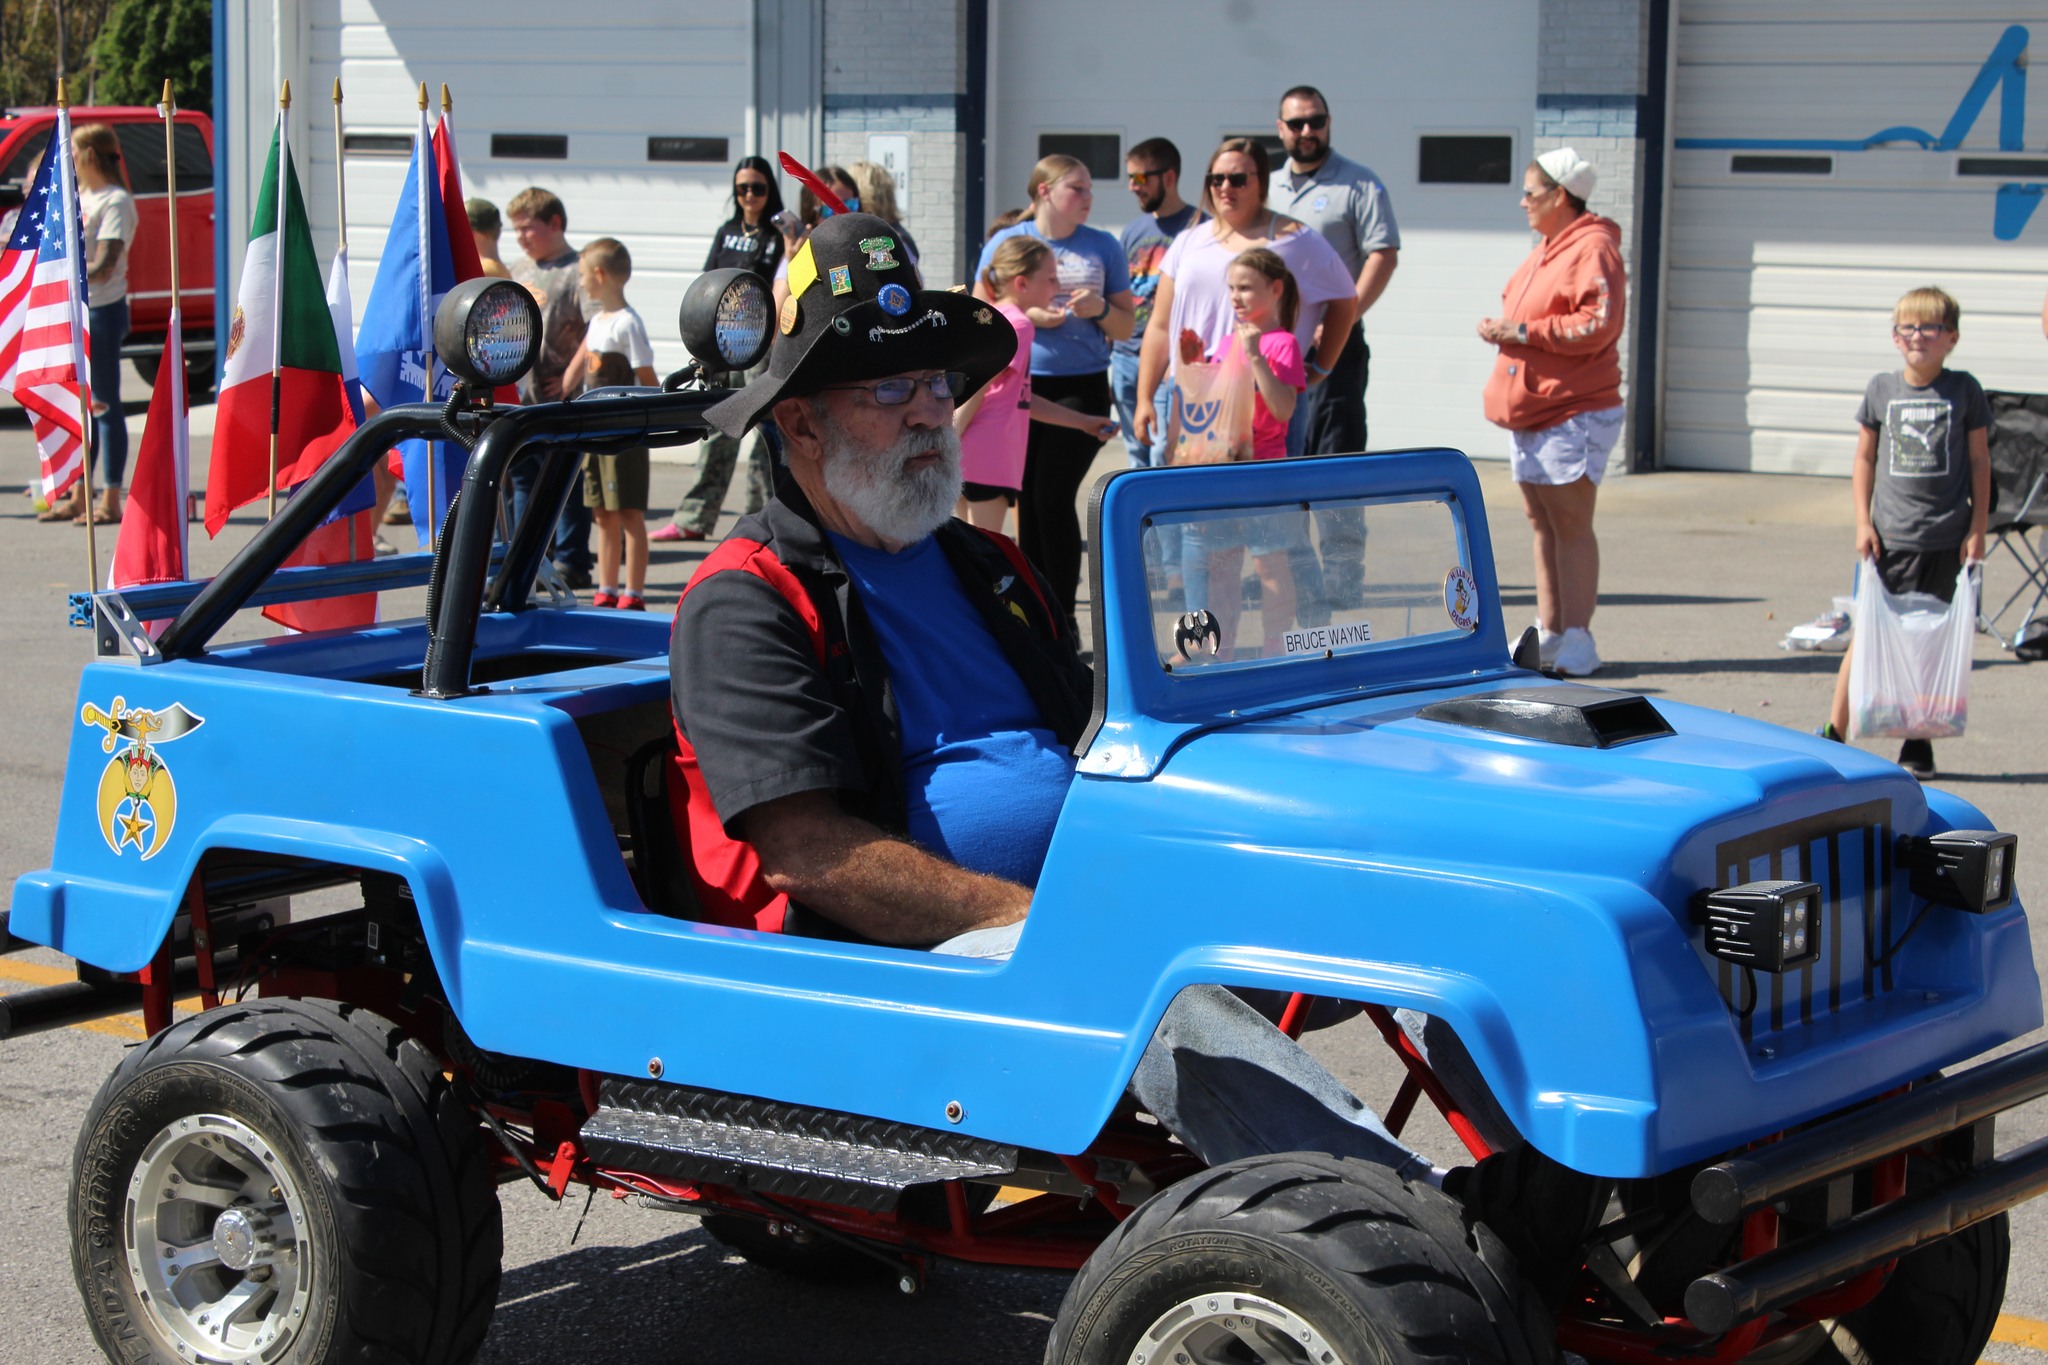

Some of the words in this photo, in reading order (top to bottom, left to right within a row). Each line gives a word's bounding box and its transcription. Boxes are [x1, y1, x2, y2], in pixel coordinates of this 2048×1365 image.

[1450, 569, 1476, 591] HILLBILLY
[1452, 610, 1472, 627] DEGREE
[1286, 631, 1327, 652] BRUCE
[1328, 624, 1371, 646] WAYNE
[219, 1073, 264, 1102] ROTATION
[304, 1158, 331, 1219] ROTATION
[1169, 1236, 1229, 1251] ROTATION
[1304, 1270, 1360, 1320] ROTATION
[94, 1257, 158, 1365] ENDA
[1075, 1285, 1110, 1342] ROTATION
